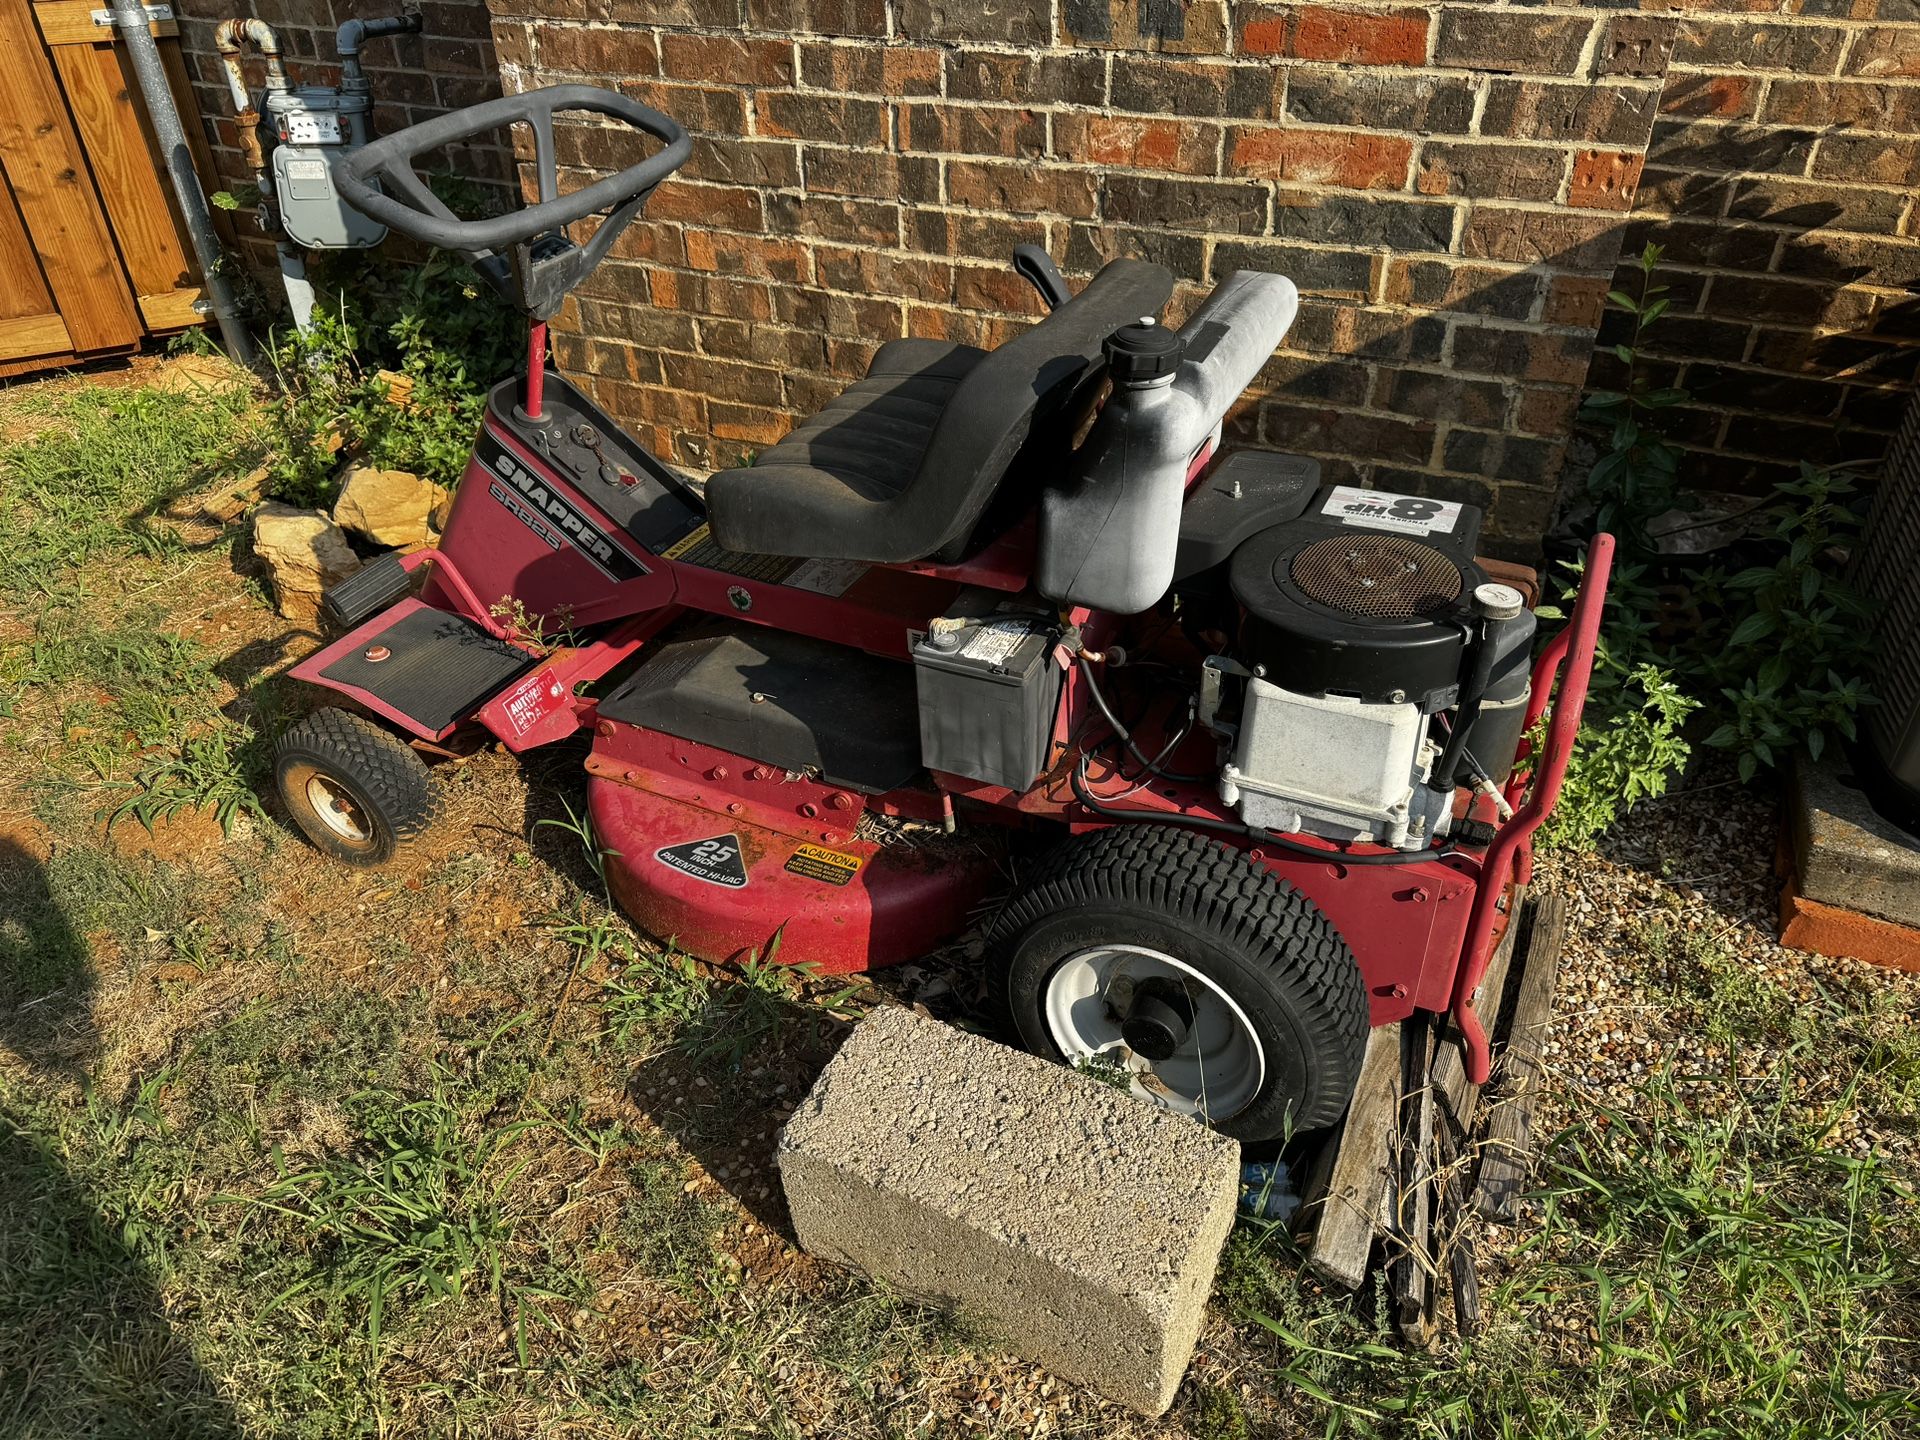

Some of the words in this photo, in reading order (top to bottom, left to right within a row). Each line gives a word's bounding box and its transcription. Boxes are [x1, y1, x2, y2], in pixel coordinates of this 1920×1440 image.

[489, 482, 562, 551] SR825
[495, 455, 613, 562] SNAPPER
[690, 854, 717, 867] INCH
[691, 840, 738, 862] 25
[808, 847, 850, 867] CAUTION
[660, 851, 708, 876] PATENTED
[707, 871, 742, 885] HI-VAC
